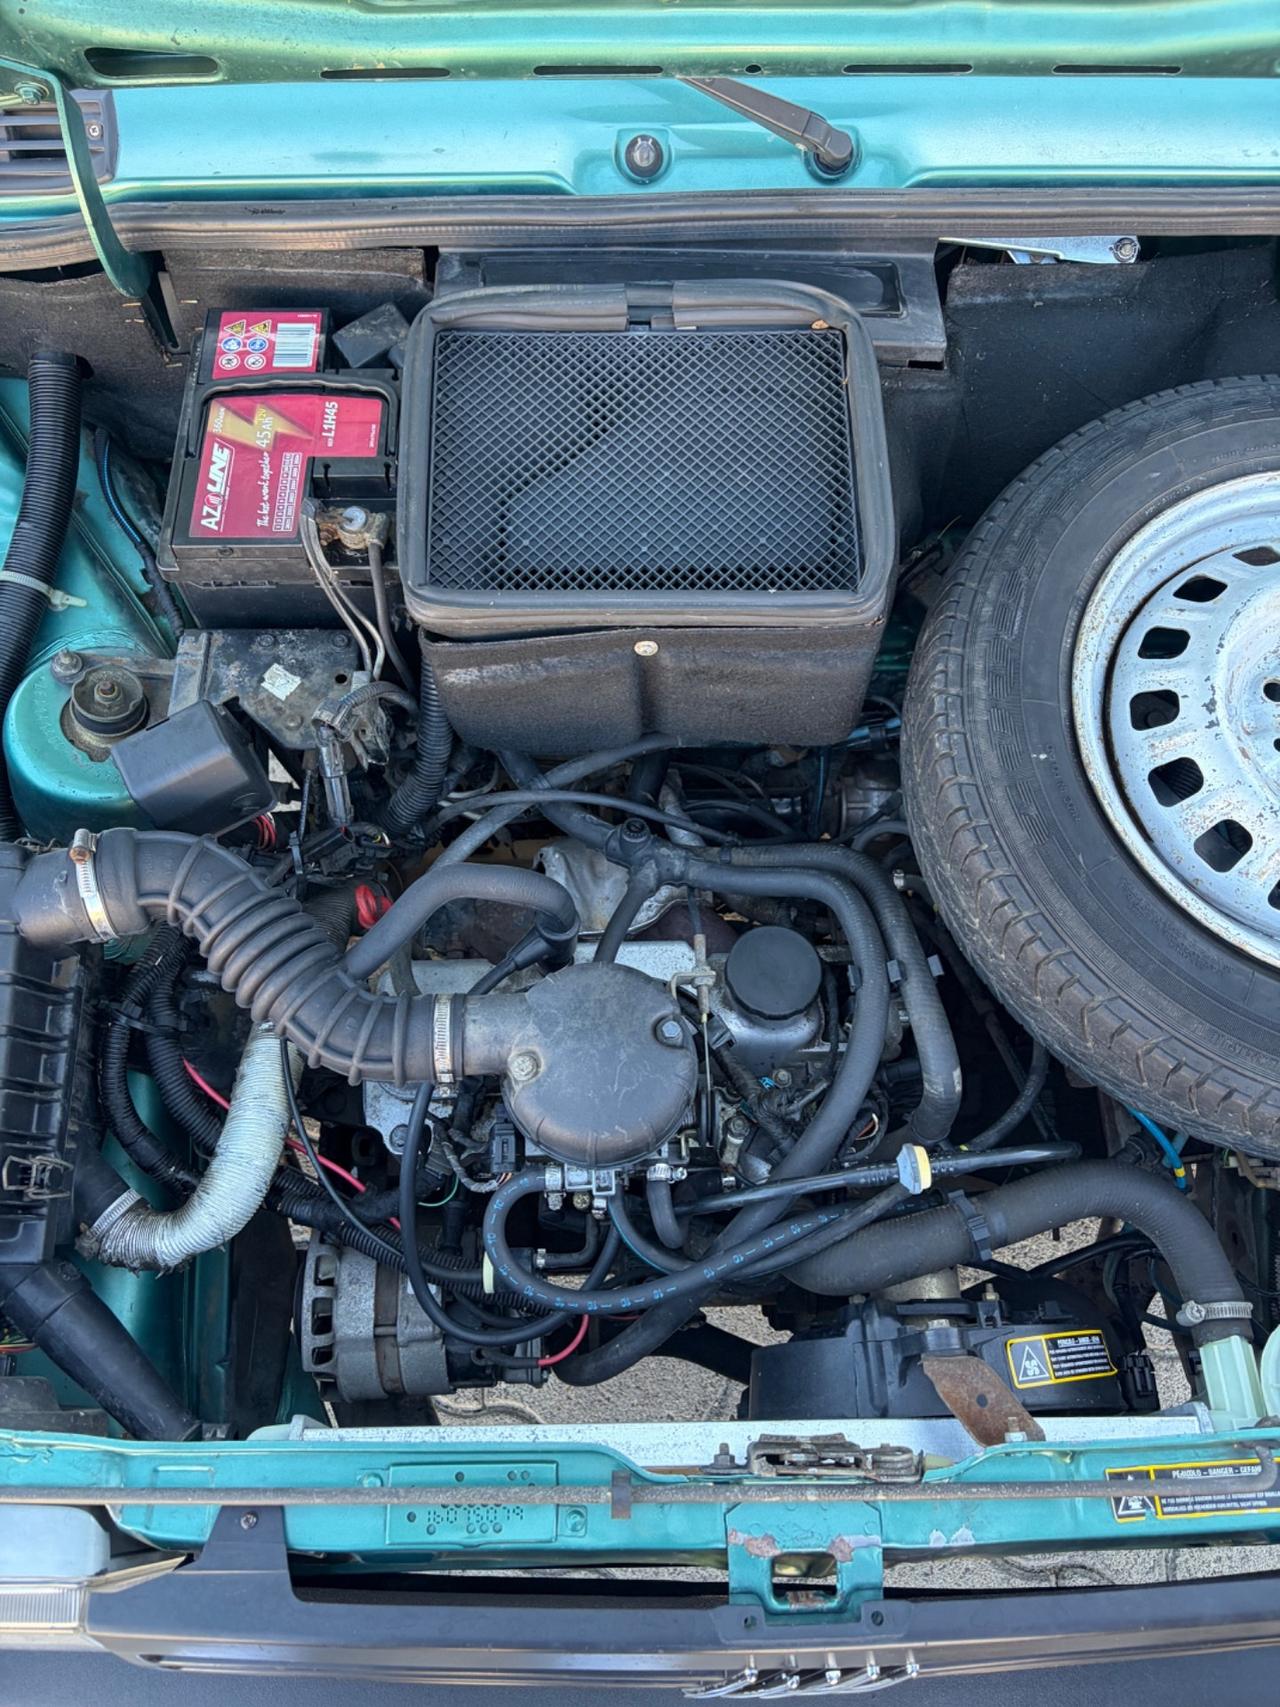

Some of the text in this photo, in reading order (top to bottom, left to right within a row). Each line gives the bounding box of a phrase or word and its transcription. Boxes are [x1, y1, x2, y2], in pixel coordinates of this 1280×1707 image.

[321, 401, 339, 437] L1H45
[258, 451, 273, 480] together
[257, 480, 270, 501] work
[256, 516, 269, 527] The
[427, 1506, 524, 1524] 16075079
